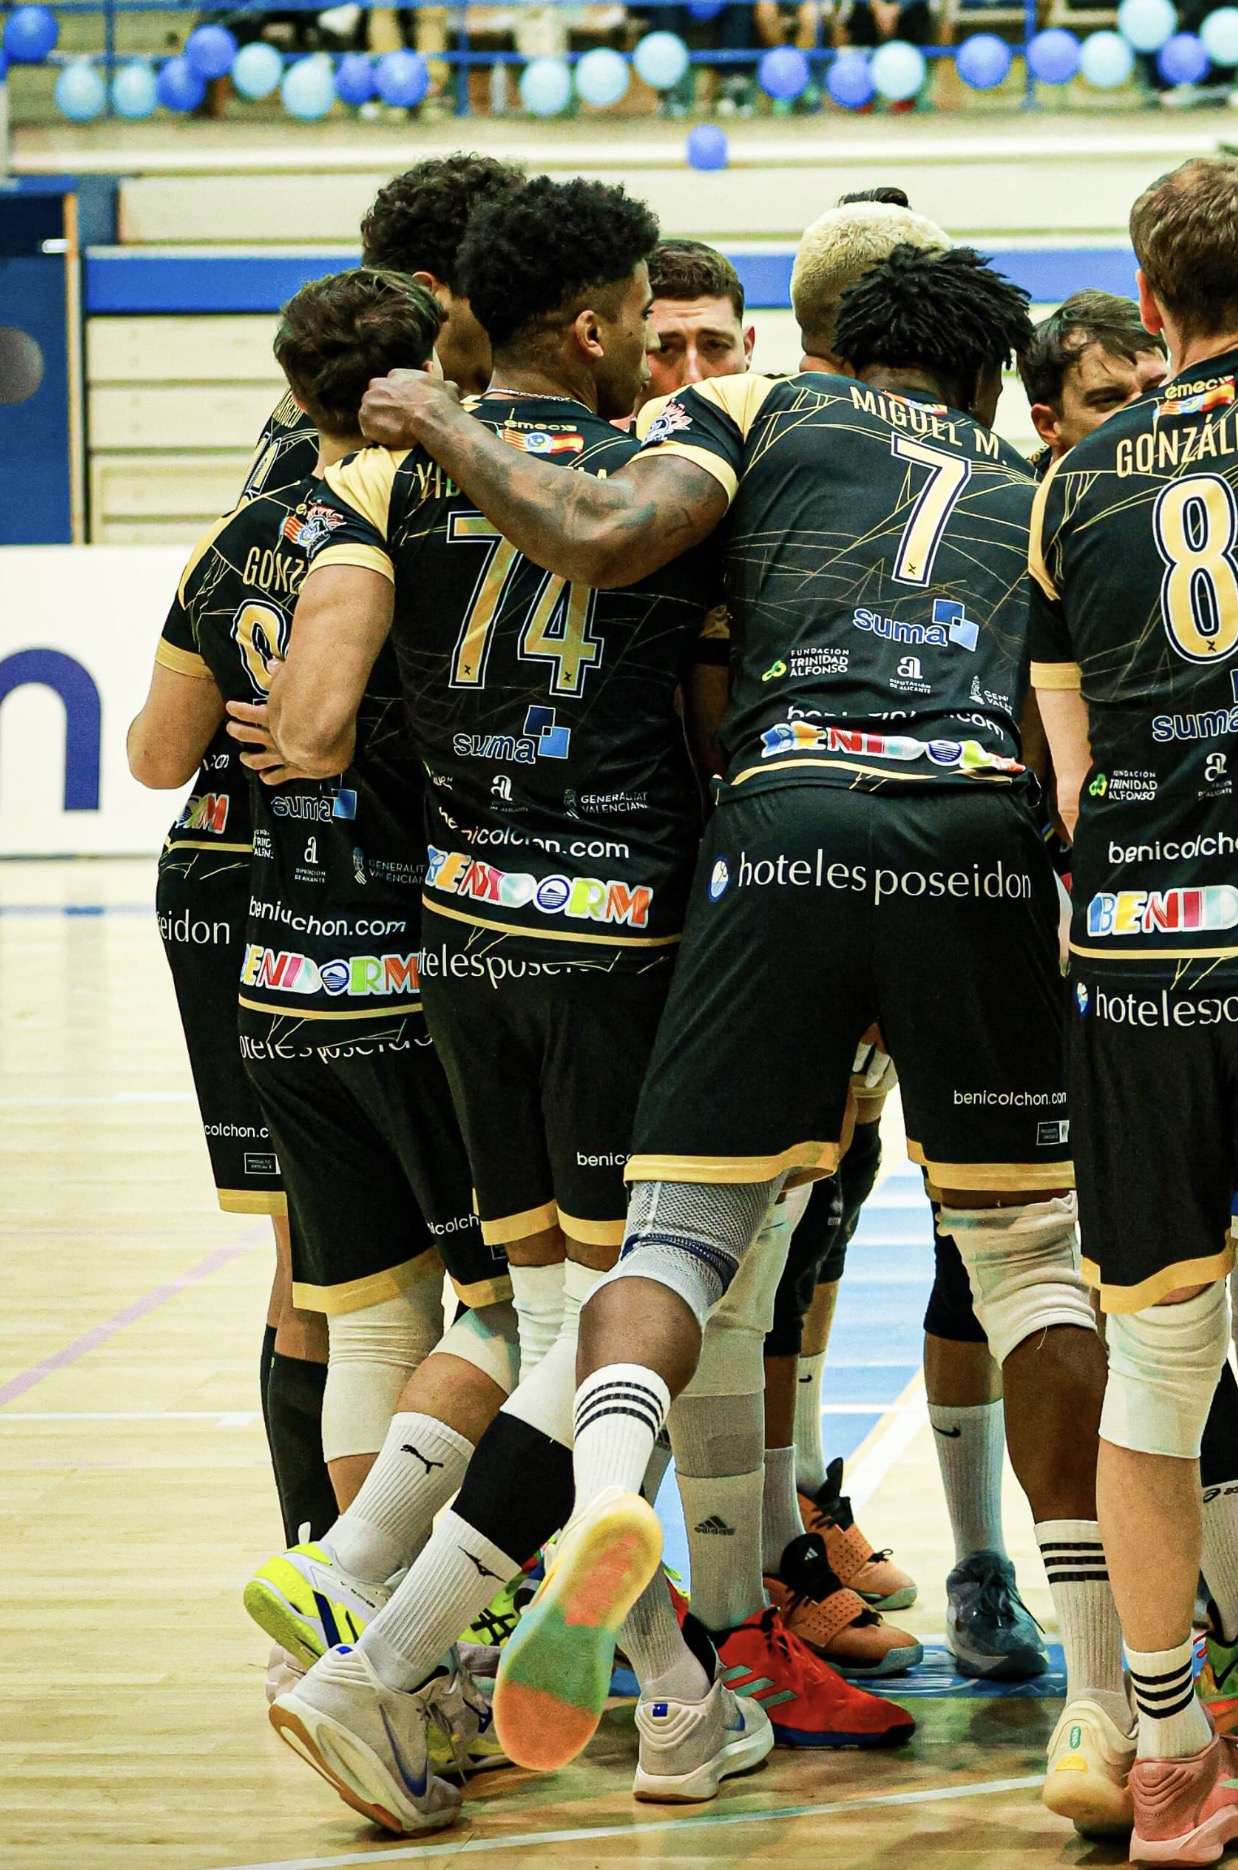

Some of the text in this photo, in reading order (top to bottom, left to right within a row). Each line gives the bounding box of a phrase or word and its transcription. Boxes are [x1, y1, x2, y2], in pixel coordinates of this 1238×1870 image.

[849, 385, 1010, 467] MIGUEL M.
[890, 430, 973, 589] 7
[445, 509, 605, 698] 74
[852, 607, 949, 648] suma
[789, 664, 848, 678] ALFONSO
[790, 655, 849, 668] TRINIDAD
[453, 732, 536, 765] suma
[1108, 777, 1159, 791] TRINIDAD
[1108, 790, 1157, 802] ALFONSO
[270, 795, 334, 824] suma
[156, 908, 231, 945] eidon
[239, 942, 421, 997] ENIDORM
